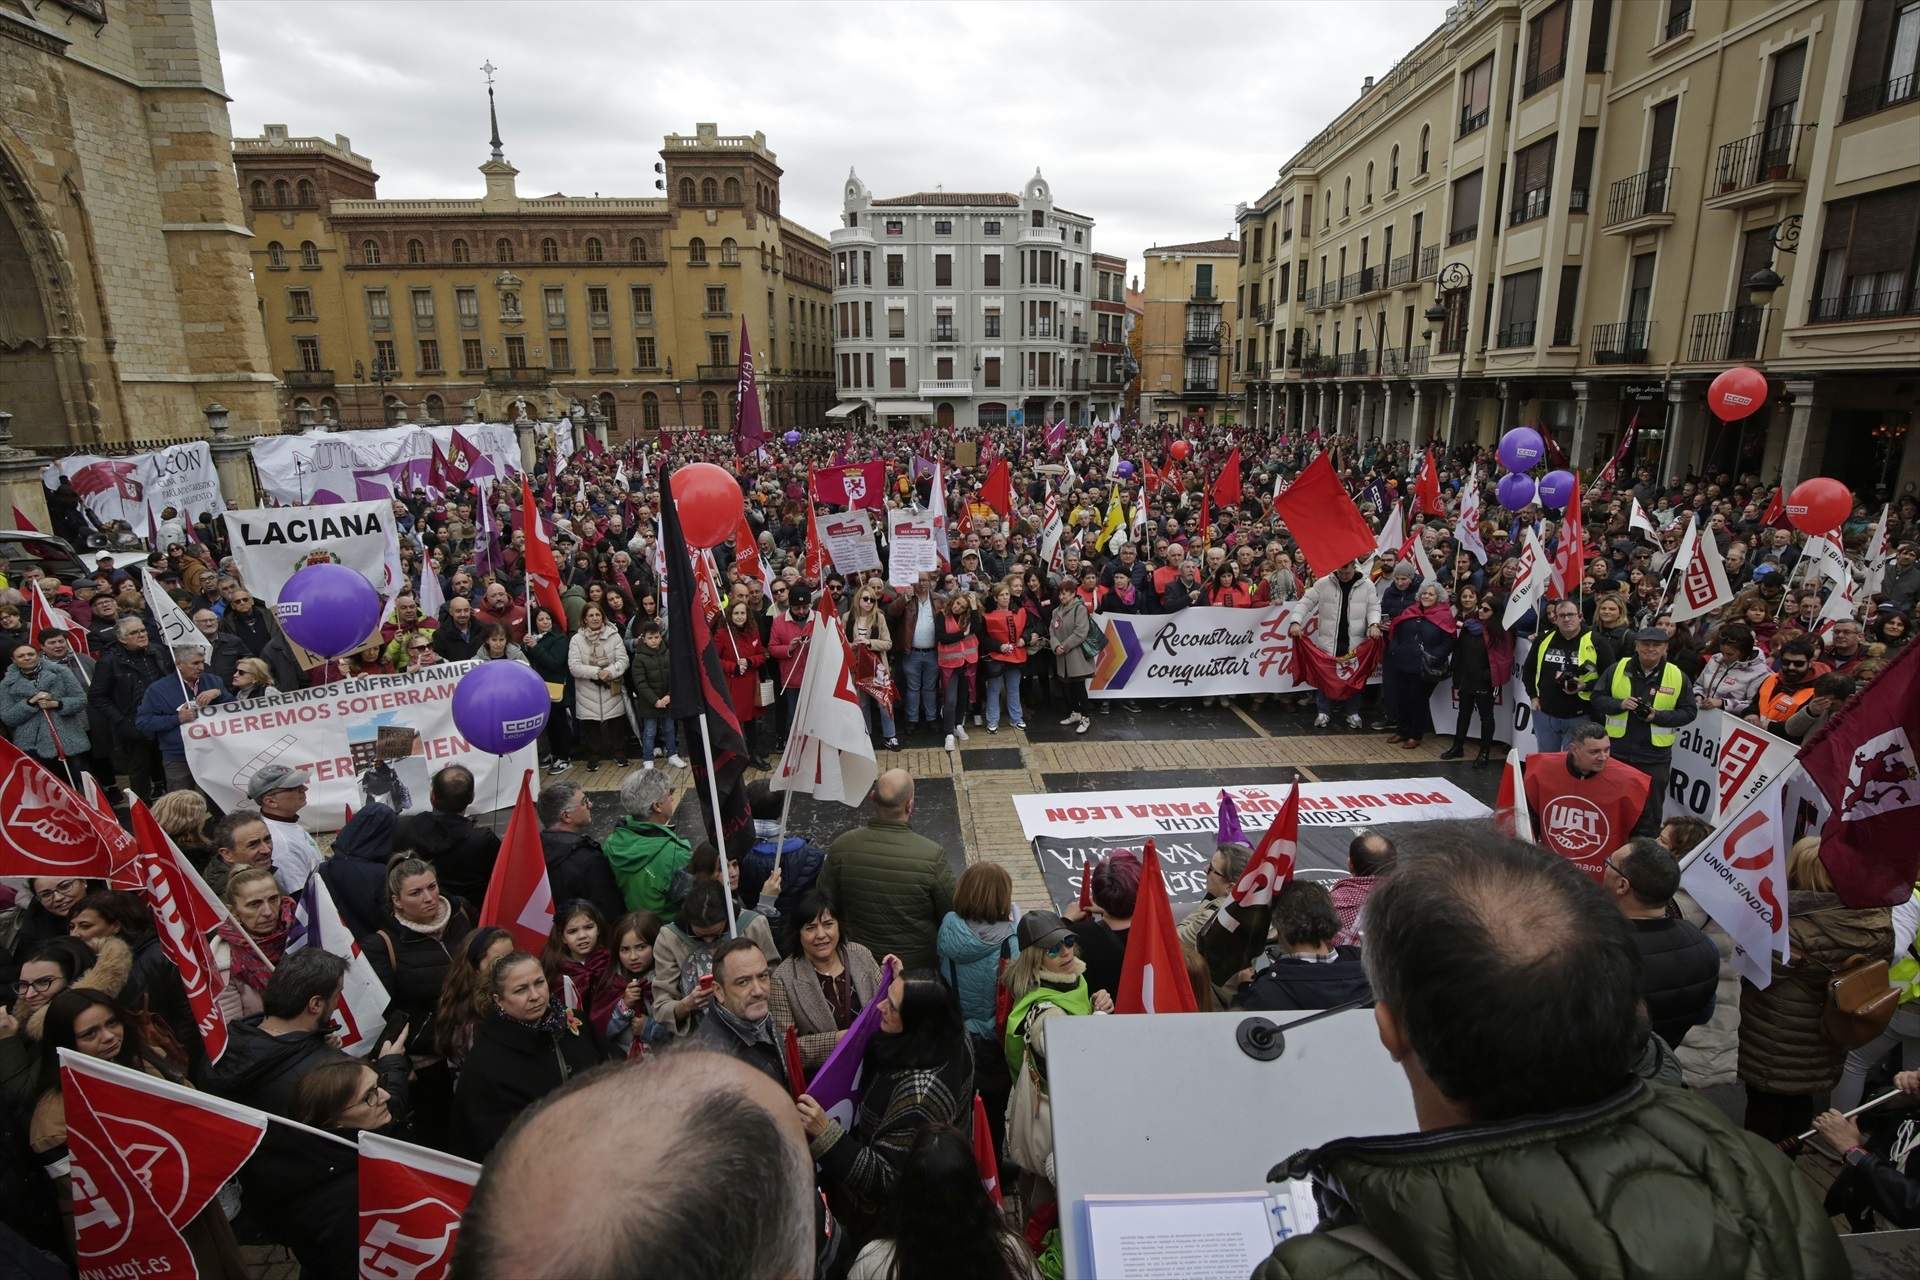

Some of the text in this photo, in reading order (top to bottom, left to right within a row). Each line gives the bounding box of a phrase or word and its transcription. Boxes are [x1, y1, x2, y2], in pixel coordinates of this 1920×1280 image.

[1727, 395, 1750, 404] CCOO
[240, 513, 382, 546] LACIANA
[1152, 621, 1255, 657] Reconstruir
[1146, 655, 1251, 687] conquistar
[223, 684, 339, 714] QUEREMOS
[188, 703, 331, 741] QUEREMOS
[506, 718, 544, 734] CCOO
[1676, 727, 1721, 768] abaj
[1126, 801, 1215, 818] PARA
[1336, 794, 1387, 808] UN
[1382, 791, 1453, 805] POR
[1045, 806, 1124, 825] LEÓN
[1549, 804, 1600, 835] UGT
[1703, 852, 1738, 886] UNIÓN
